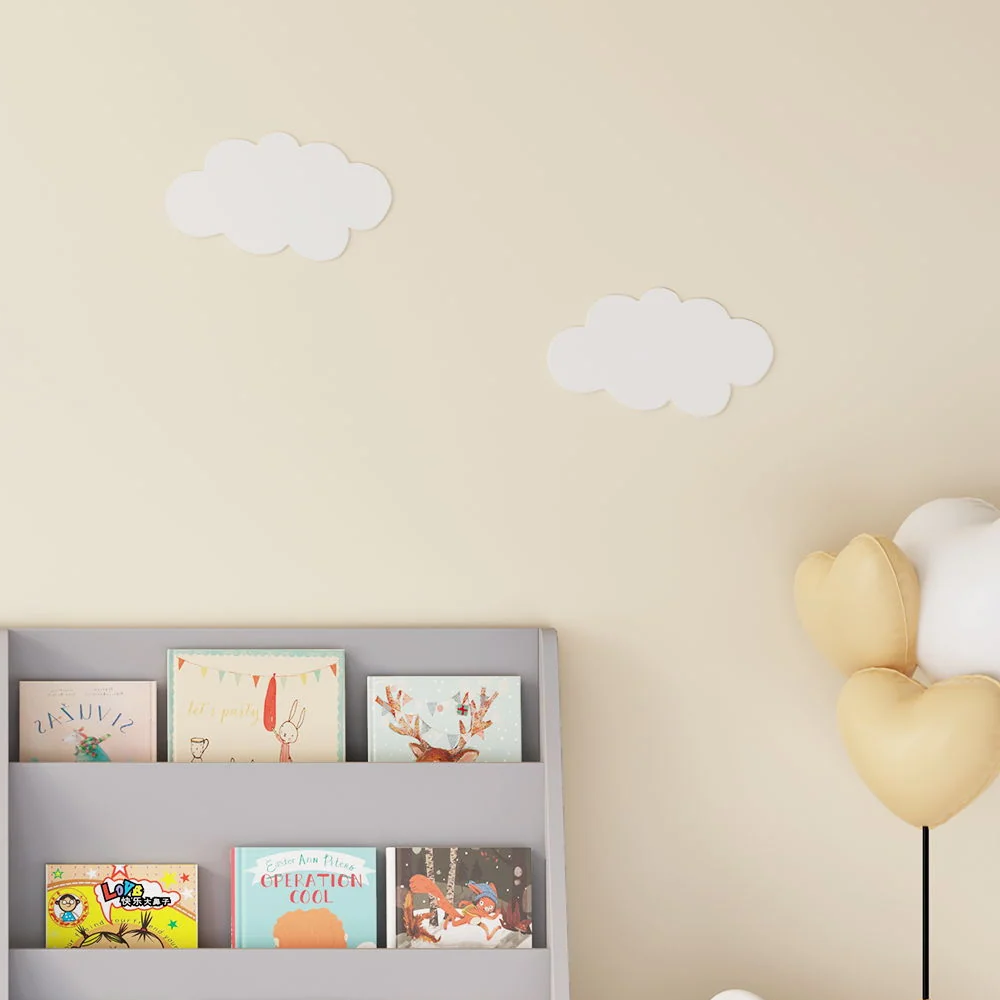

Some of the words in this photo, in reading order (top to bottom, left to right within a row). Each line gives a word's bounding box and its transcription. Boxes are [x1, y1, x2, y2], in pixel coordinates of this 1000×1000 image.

[260, 873, 363, 888] OPERATION
[120, 896, 172, 908] 快乐大鼻子
[289, 889, 334, 904] COOL
